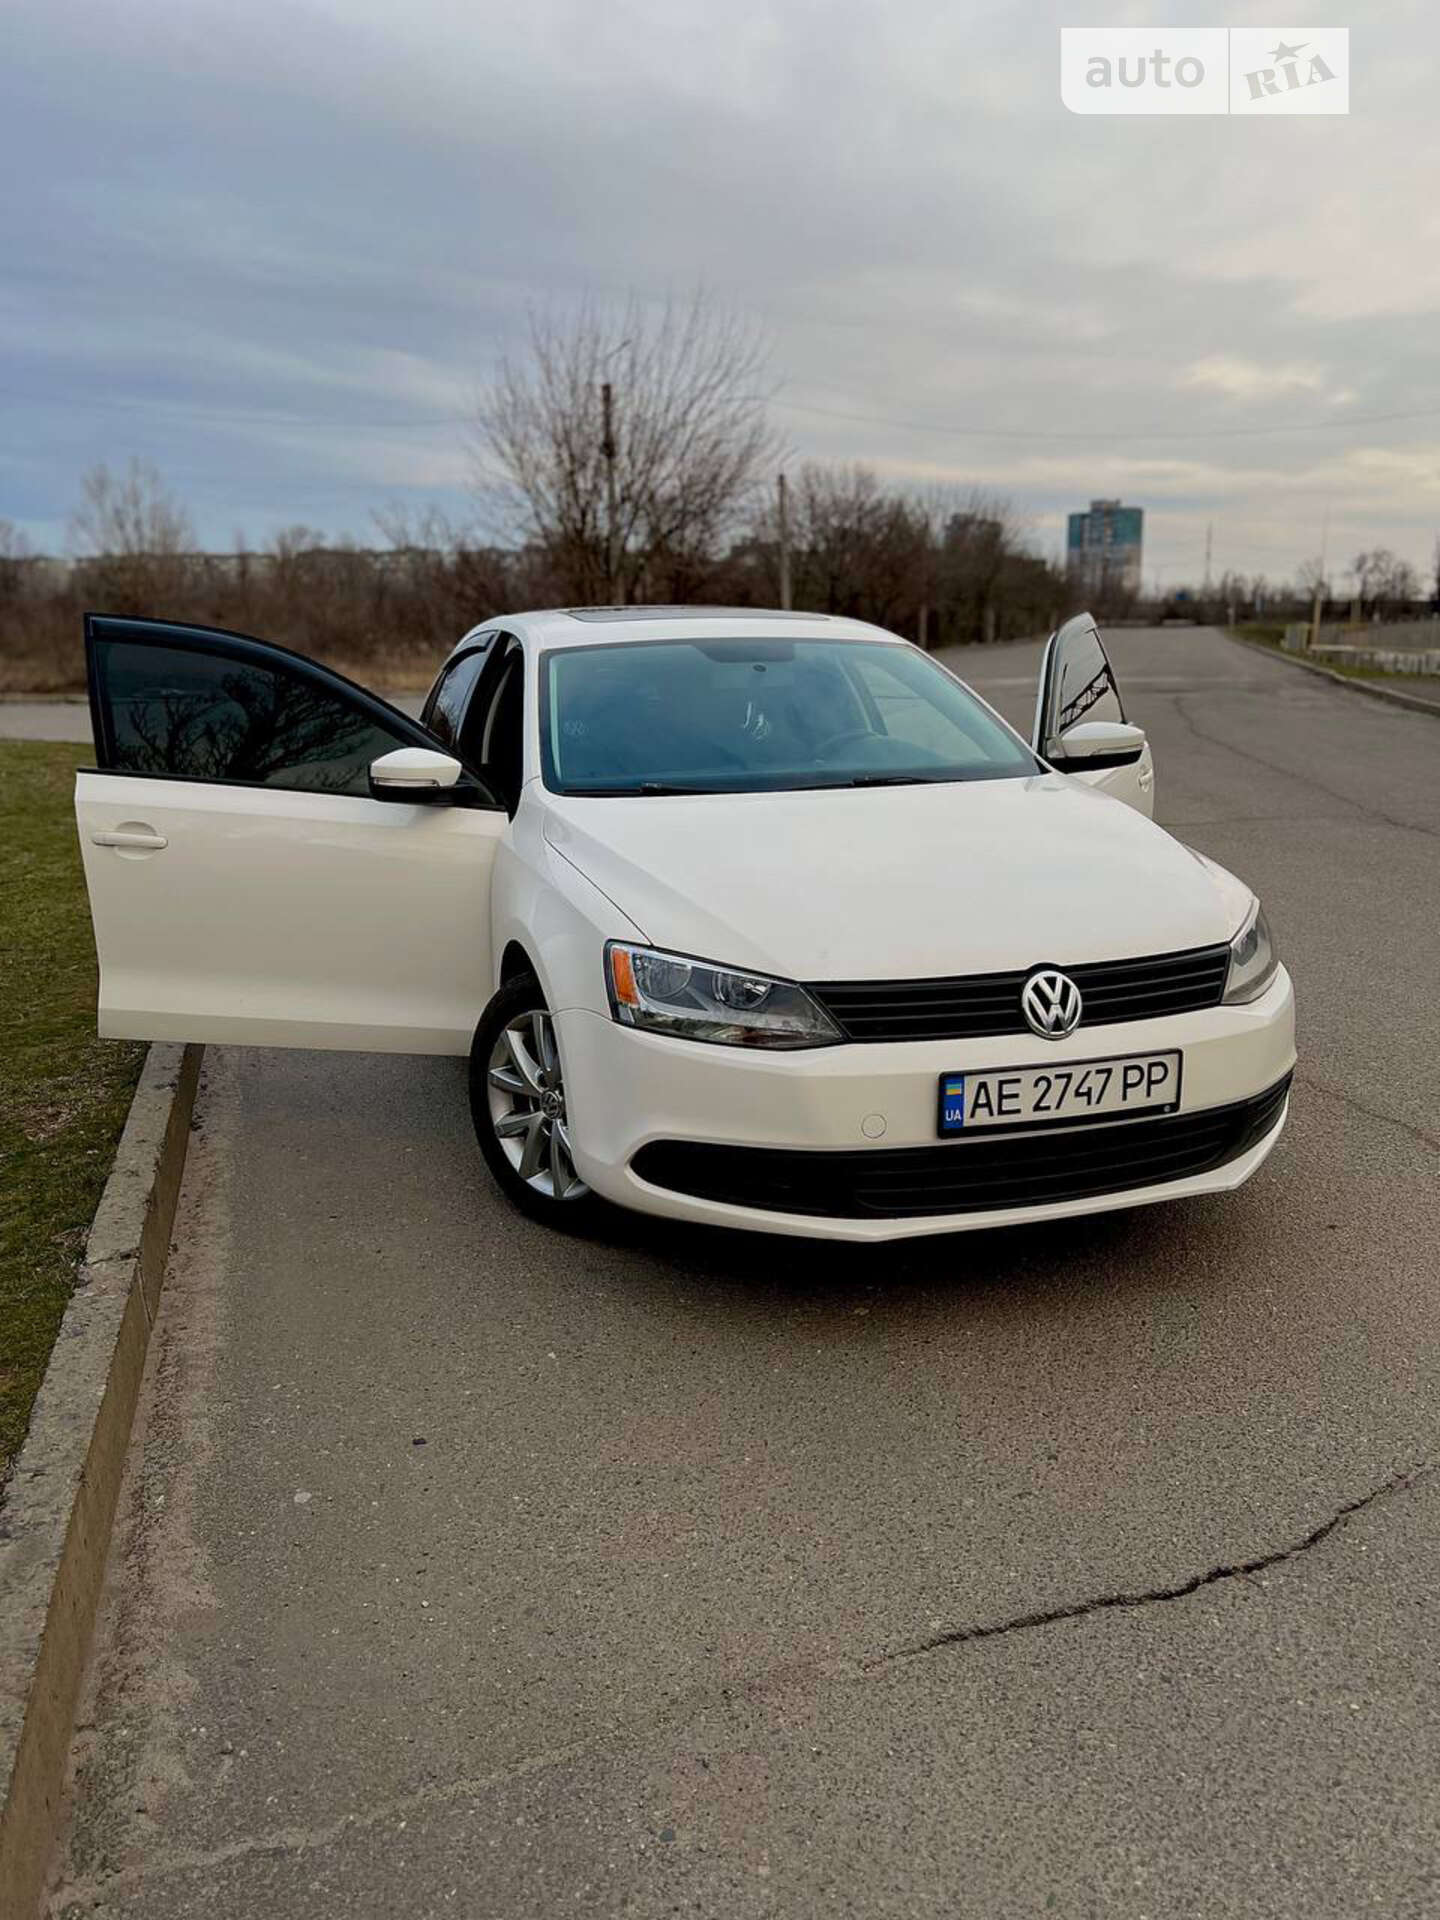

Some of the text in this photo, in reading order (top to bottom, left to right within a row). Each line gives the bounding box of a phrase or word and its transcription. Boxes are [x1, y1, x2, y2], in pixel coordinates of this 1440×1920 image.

[1026, 973, 1080, 1036] VW
[945, 1110, 962, 1121] UA
[970, 1061, 1168, 1118] AE 2747 PP
